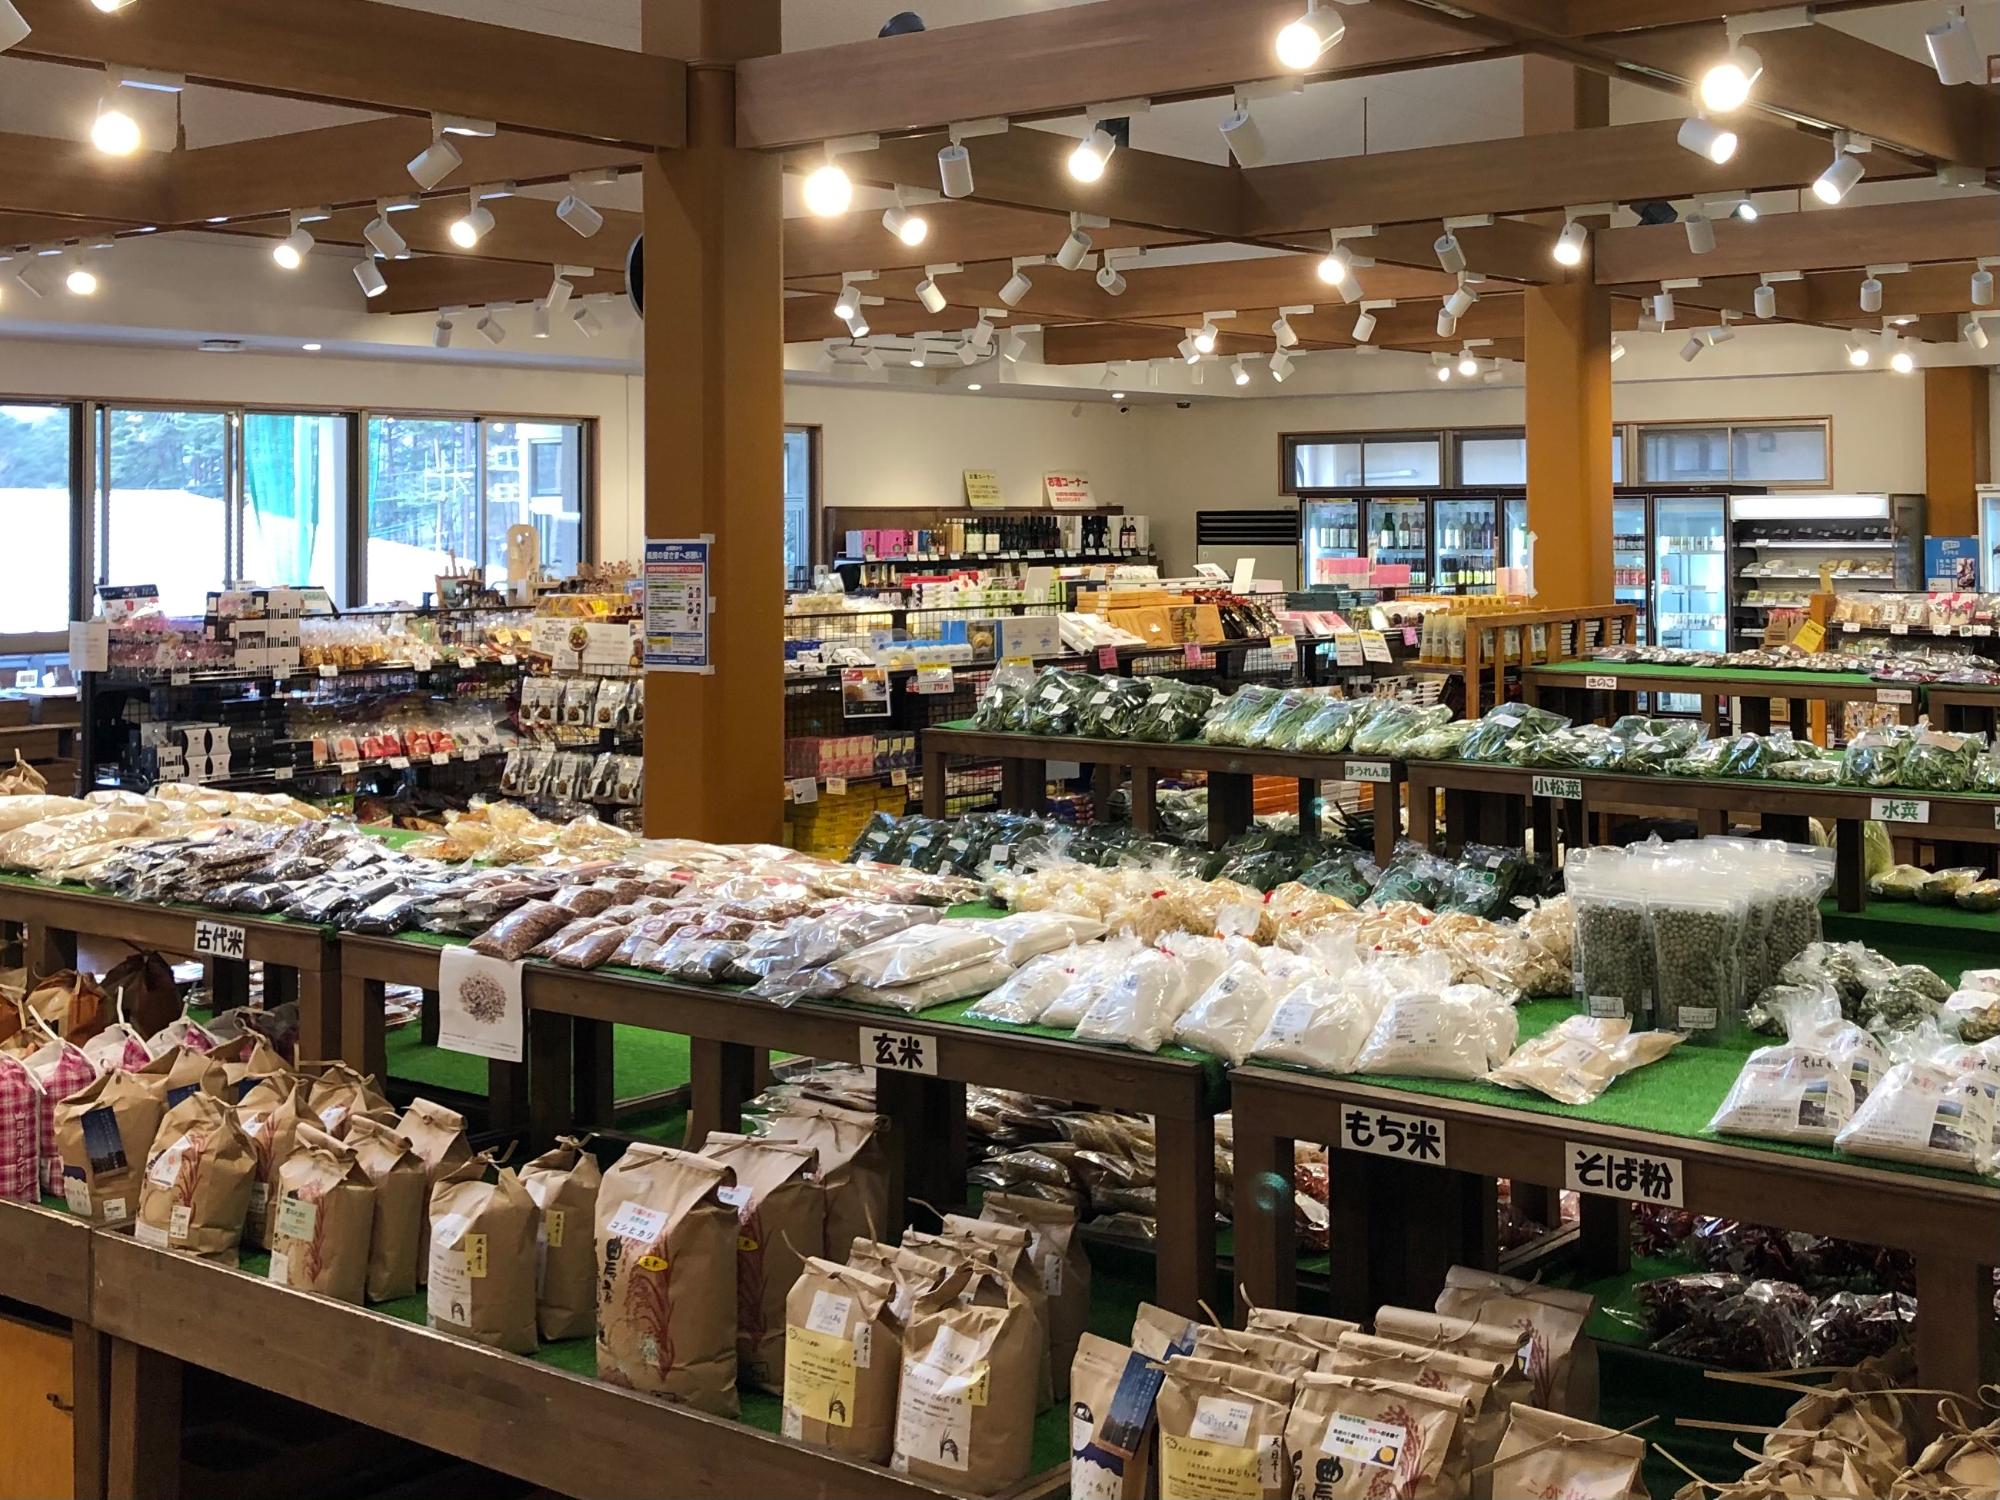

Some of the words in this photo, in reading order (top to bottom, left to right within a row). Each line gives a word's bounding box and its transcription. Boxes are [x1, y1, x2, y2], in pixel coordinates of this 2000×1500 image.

[1587, 677, 1615, 688] きのこ
[1345, 765, 1390, 778] ほうれん草
[1534, 777, 1581, 798] 小松菜
[1881, 800, 1919, 820] 水菜
[196, 923, 243, 956] 古代米
[873, 1032, 923, 1069] 玄米
[1345, 1110, 1441, 1159] もち米
[1574, 1150, 1673, 1200] そば粉
[611, 1221, 655, 1239] コシヒカリ
[1271, 1437, 1280, 1482] 天日干し
